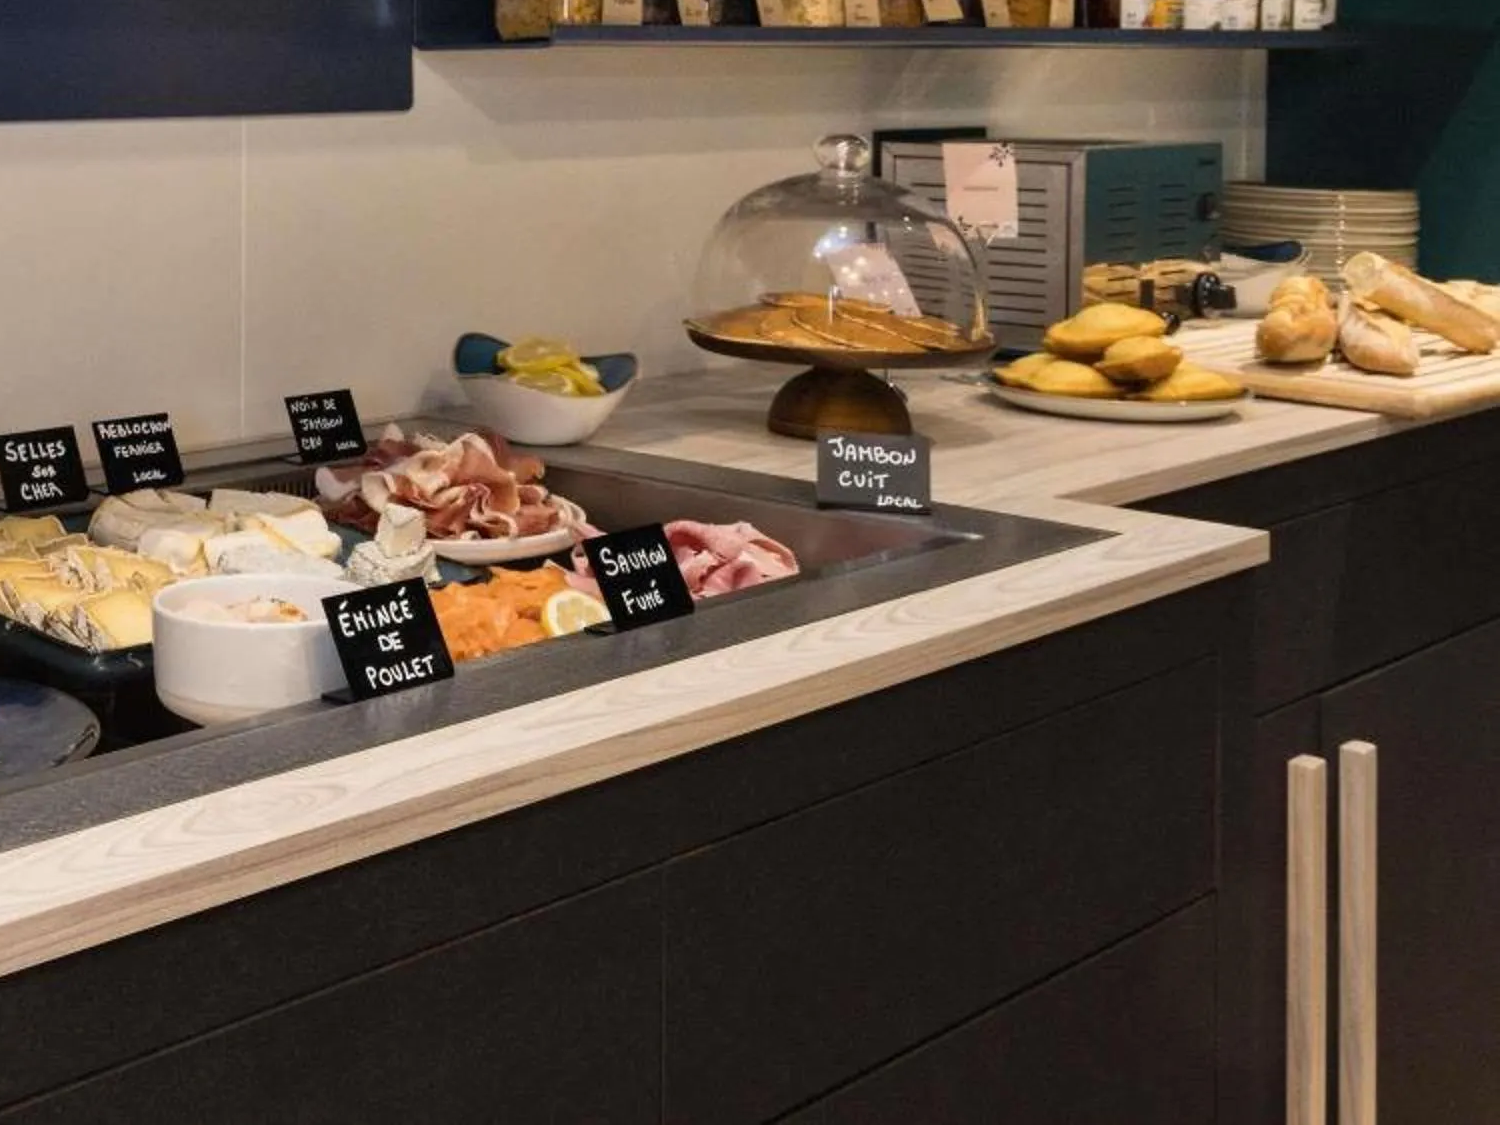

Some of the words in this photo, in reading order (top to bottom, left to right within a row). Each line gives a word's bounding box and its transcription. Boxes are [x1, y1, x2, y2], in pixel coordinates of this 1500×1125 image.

[4, 439, 66, 462] SELLES
[827, 436, 917, 465] JAMBON
[21, 481, 64, 501] CHER
[876, 495, 924, 509] LOCAL
[600, 542, 667, 576] SAUMON
[621, 579, 665, 615] FUMÉ
[377, 631, 404, 652] DE
[365, 655, 434, 690] POULET
